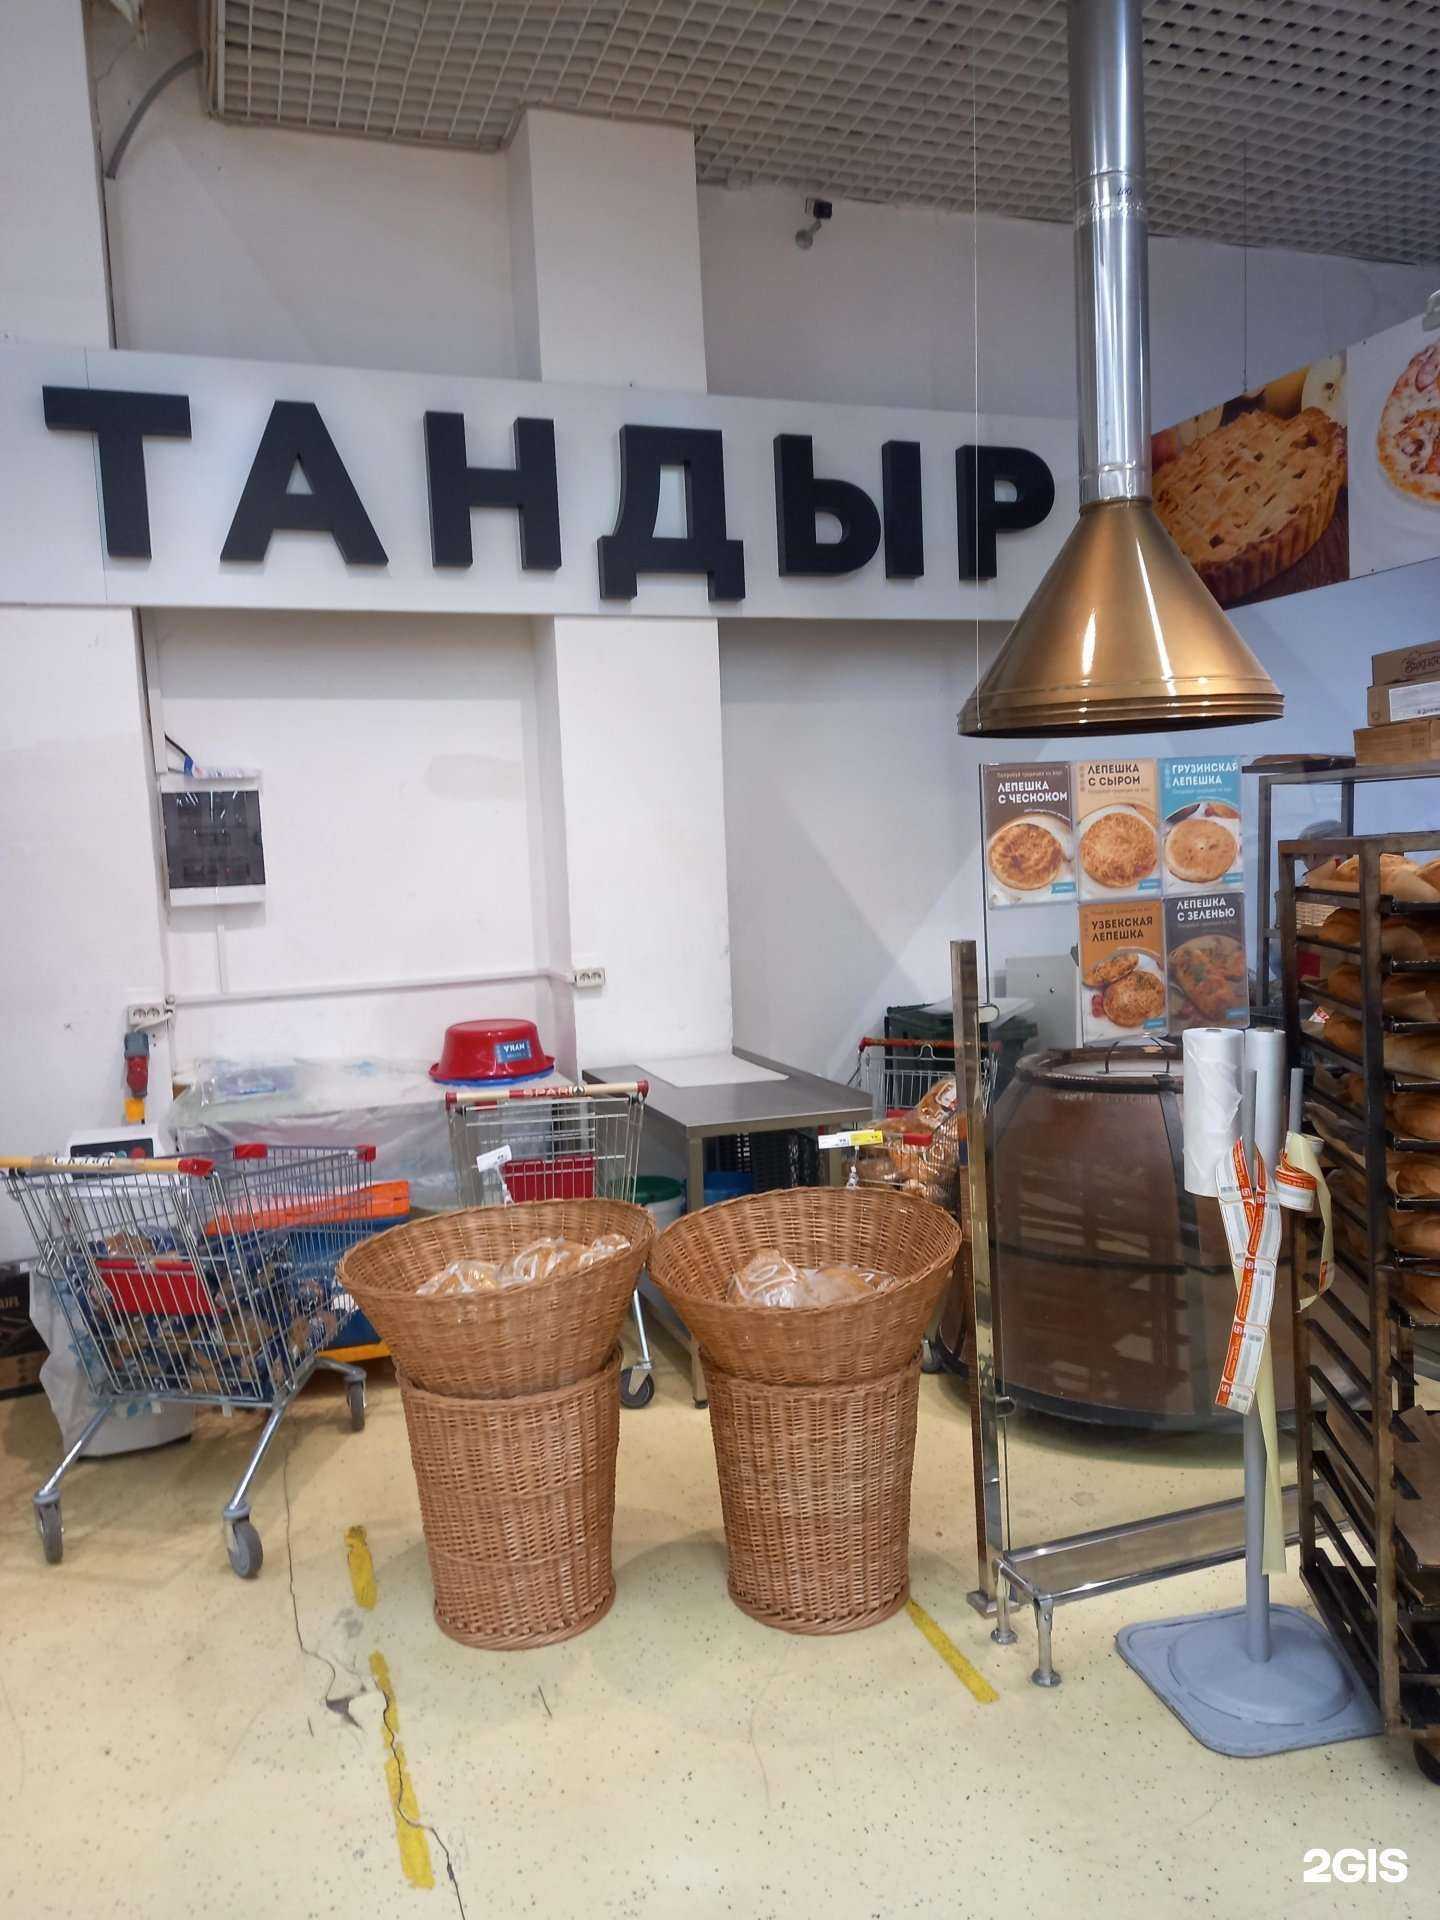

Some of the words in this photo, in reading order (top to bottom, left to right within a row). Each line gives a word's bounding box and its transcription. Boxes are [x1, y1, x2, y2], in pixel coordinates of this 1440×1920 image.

[43, 386, 1055, 599] ТАНДЫР
[1088, 763, 1139, 775] ЛЕПЕШКА
[1172, 762, 1238, 775] ГРУЗИНСКАЯ
[997, 780, 1049, 793] ЛЕПЕШКА
[1088, 777, 1096, 786] С
[1099, 775, 1140, 786] СЫРОМ
[1172, 775, 1222, 786] ЛЕПЕШКА
[998, 794, 1006, 804] С
[1009, 791, 1068, 804] ЧЕСНОКОМ
[1177, 897, 1226, 910] ЛЕПЕШКА
[1177, 912, 1185, 921] С
[1187, 907, 1235, 920] ЗЕЛЕНЬЮ
[1092, 916, 1153, 930] УЗБЕКСКАЯ
[1092, 929, 1144, 942] ЛЕПЕШКА
